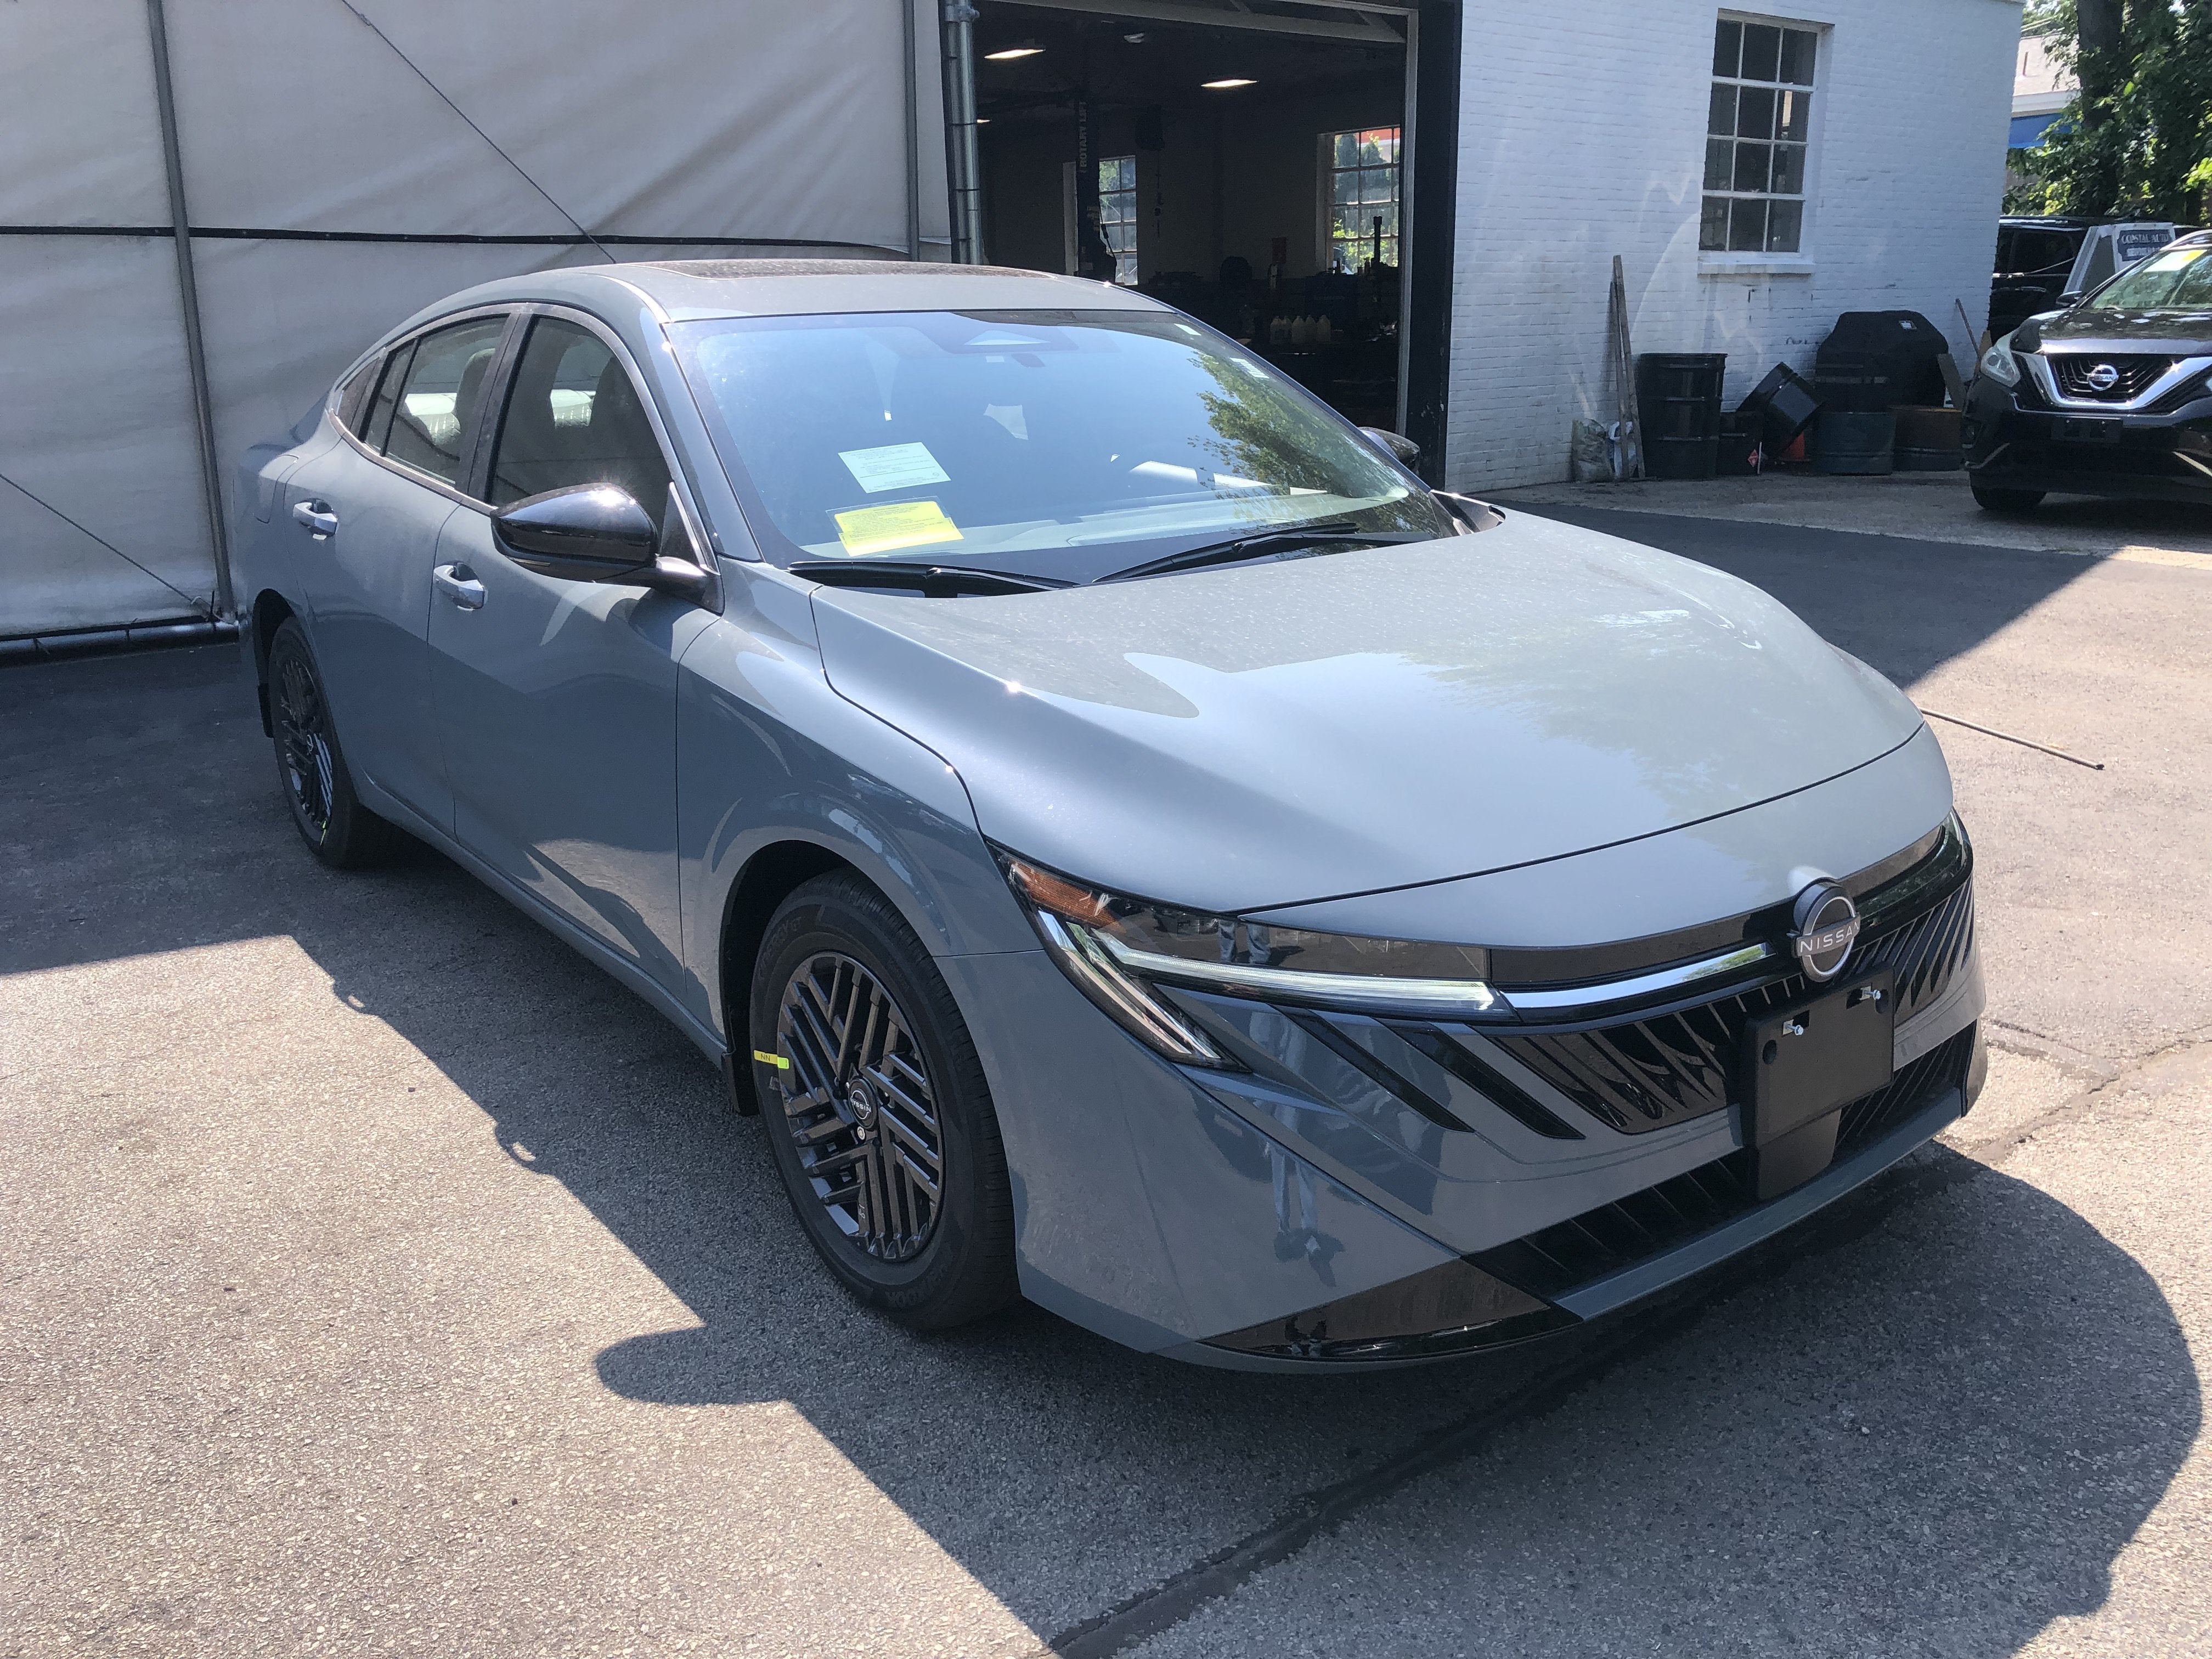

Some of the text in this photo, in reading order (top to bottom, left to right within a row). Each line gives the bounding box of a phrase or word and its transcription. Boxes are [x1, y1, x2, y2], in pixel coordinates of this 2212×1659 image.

[1079, 101, 1087, 167] ROTARY LIFT
[1800, 921, 1860, 953] NISSAN
